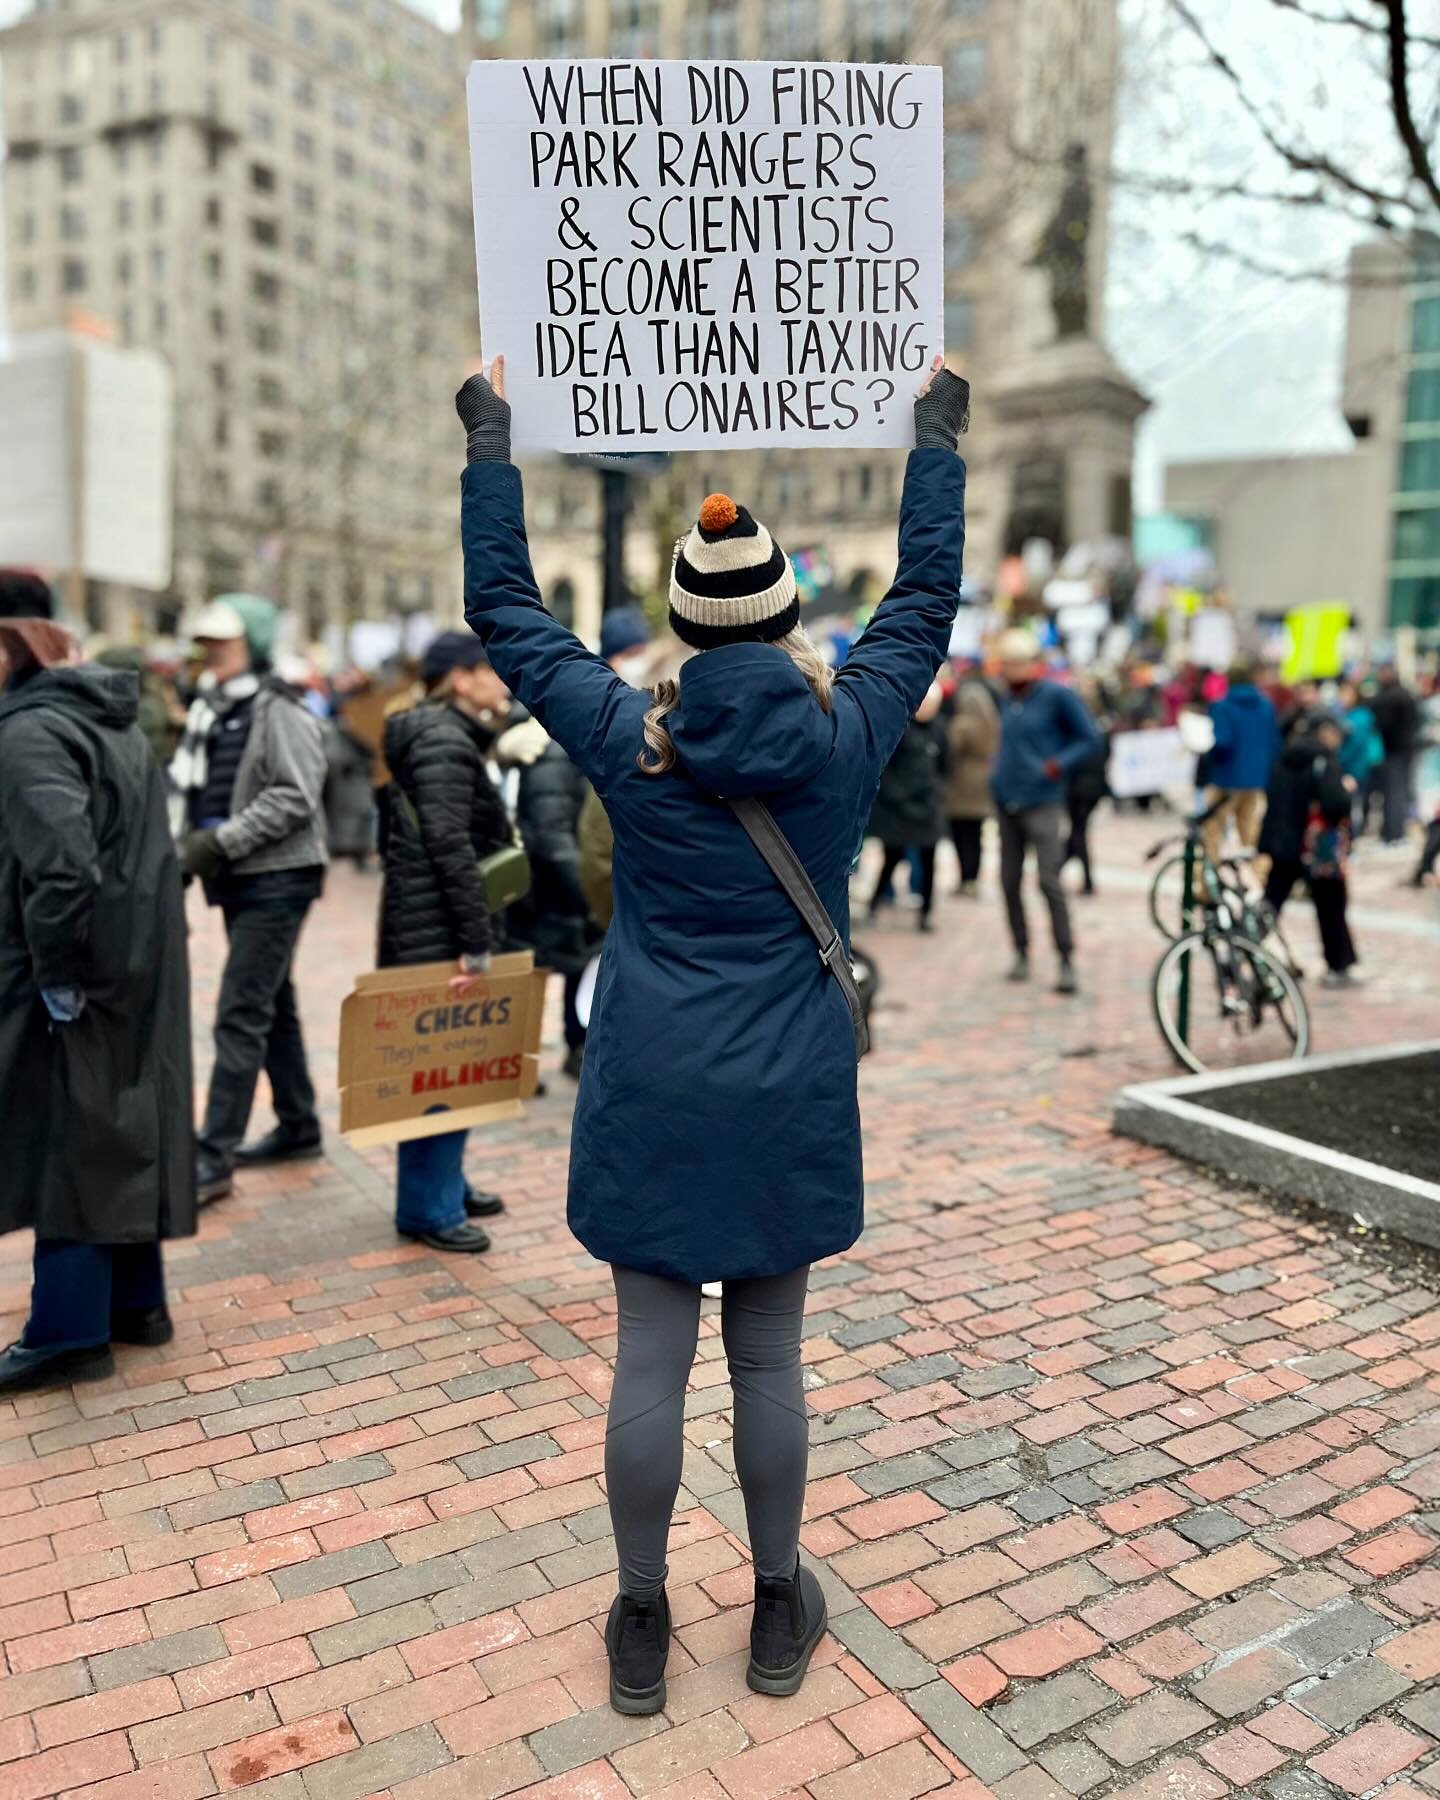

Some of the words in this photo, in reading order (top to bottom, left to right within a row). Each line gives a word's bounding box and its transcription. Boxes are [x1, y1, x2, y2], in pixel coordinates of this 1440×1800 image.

[523, 65, 664, 126] WHEN
[688, 65, 750, 126] DID
[773, 67, 923, 130] FIRING
[530, 130, 640, 188] PARK
[657, 130, 877, 191] RANGERS
[557, 196, 598, 252] &
[628, 193, 894, 254] SCIENTISTS
[546, 256, 717, 317] BECOME
[731, 258, 756, 314] A
[776, 256, 920, 316] BETTER
[535, 320, 632, 378] IDEA
[647, 319, 760, 376] THAN
[780, 319, 929, 375] TAXING
[572, 379, 895, 438] BILLONAIRES?
[414, 996, 512, 1034] CHECKS
[411, 1054, 522, 1096] BALANCES
